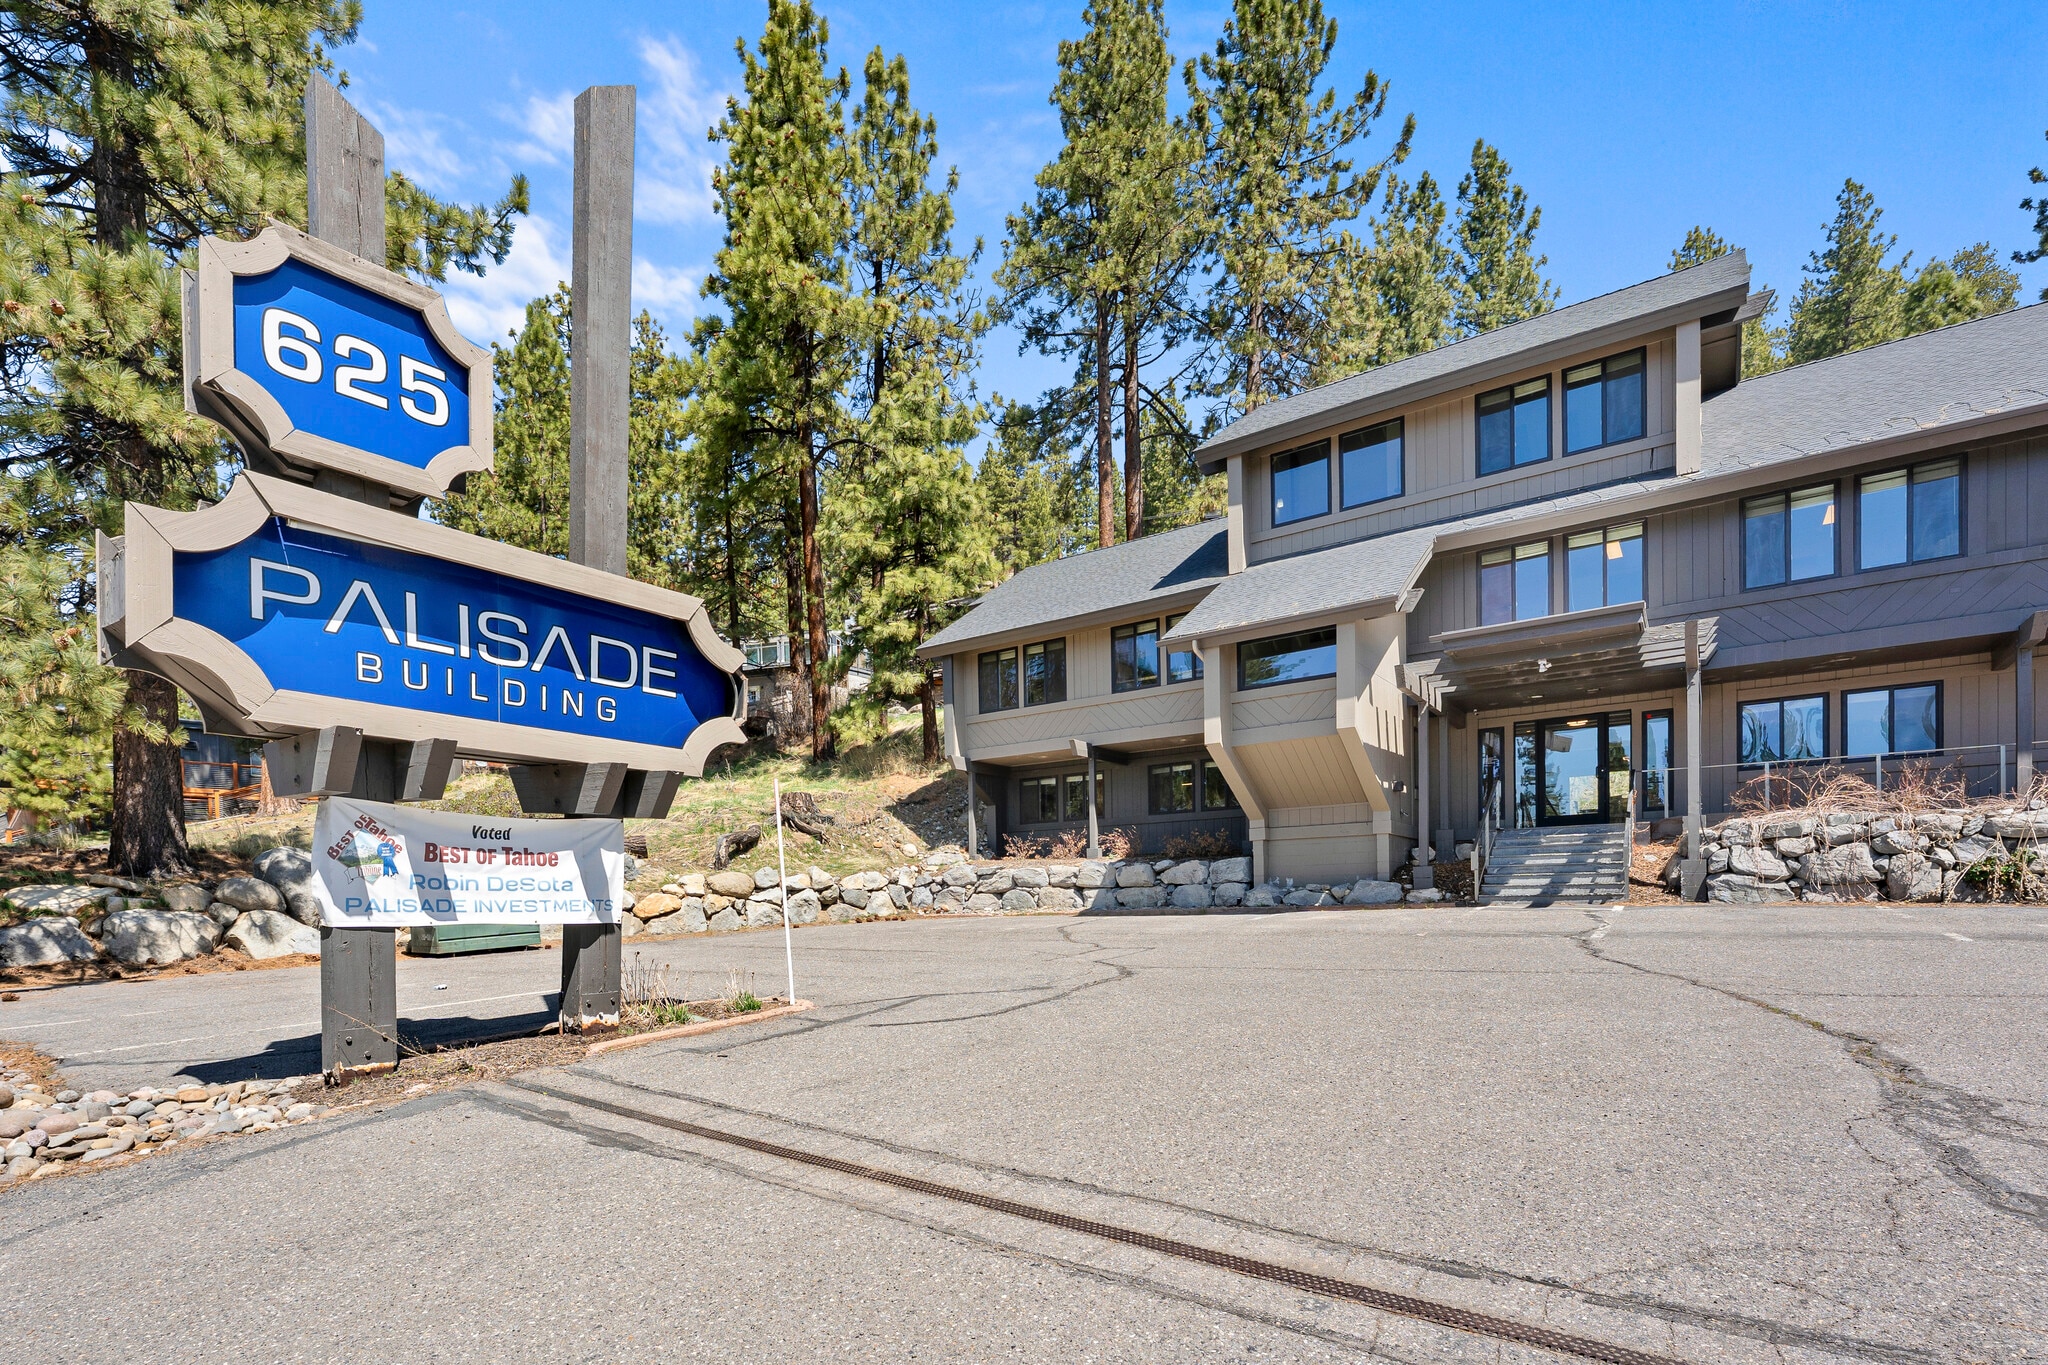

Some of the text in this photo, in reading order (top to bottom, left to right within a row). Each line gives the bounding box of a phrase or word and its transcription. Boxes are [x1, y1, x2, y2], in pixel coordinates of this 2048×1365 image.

[261, 306, 450, 427] 625
[248, 557, 678, 699] PALISADE
[355, 652, 617, 722] BUILDING
[327, 830, 354, 860] BEST
[364, 816, 402, 854] Tahoe
[472, 825, 511, 841] Voted
[424, 842, 559, 868] BEST OF Tahoe
[409, 874, 573, 892] Robin DeSota
[345, 897, 614, 913] PALISADE INVESTMENTS
